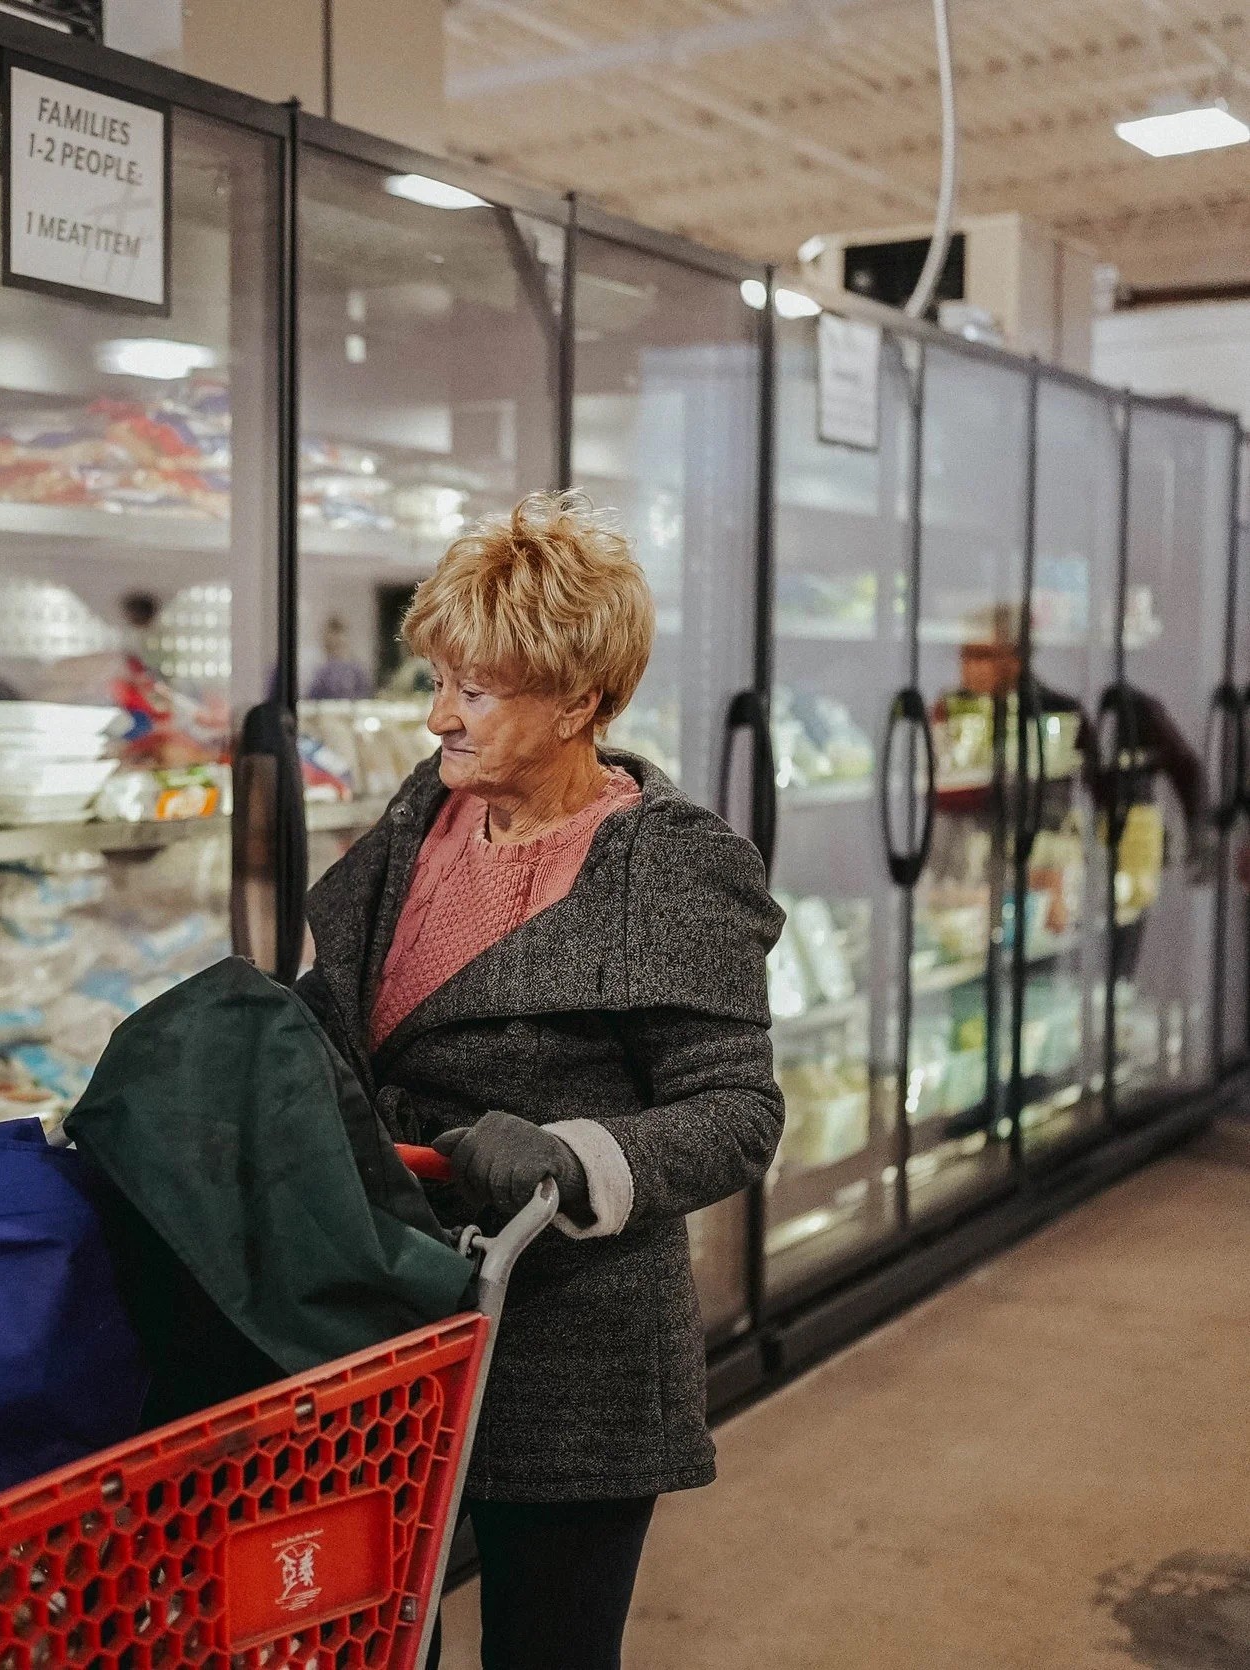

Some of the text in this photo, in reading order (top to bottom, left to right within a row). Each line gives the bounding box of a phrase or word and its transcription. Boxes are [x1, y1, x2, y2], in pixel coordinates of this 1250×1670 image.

[37, 96, 132, 147] FAMILIES
[28, 132, 55, 164] 1-2
[26, 211, 142, 259] 1 MEAT ITEM
